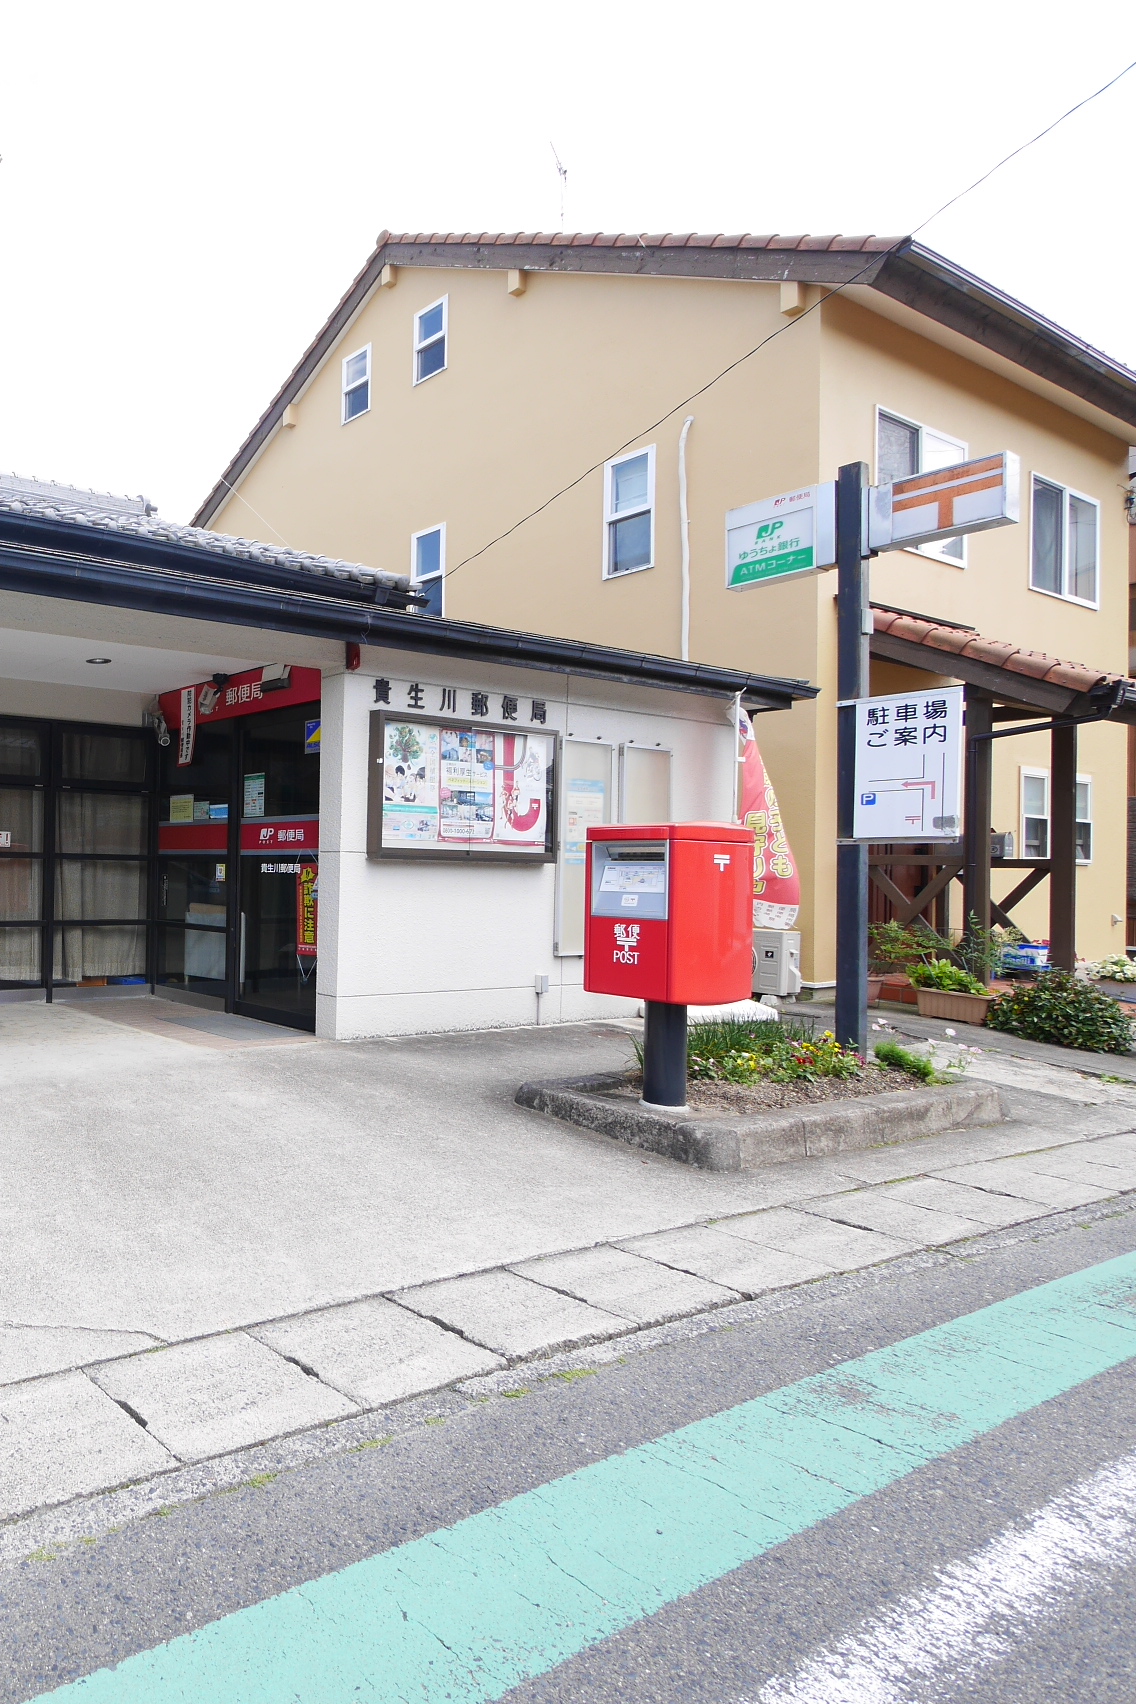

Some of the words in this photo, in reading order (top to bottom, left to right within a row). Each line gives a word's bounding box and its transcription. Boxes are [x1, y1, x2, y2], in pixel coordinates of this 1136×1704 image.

[789, 491, 811, 503] 郵便局
[756, 520, 784, 540] JP
[739, 537, 801, 561] ゆうちょ銀行
[740, 554, 807, 576] ATMコーナー
[225, 682, 263, 706] 郵便局
[373, 678, 547, 724] 貴生川郵便局
[866, 699, 948, 726] 駐車場
[866, 723, 947, 748] ご案内
[862, 794, 874, 805] P
[277, 829, 304, 842] 郵便局
[261, 863, 301, 874] 貴生川郵便局
[303, 882, 315, 944] 詐欺に注意
[613, 923, 641, 940] 郵便
[613, 950, 641, 965] POST
